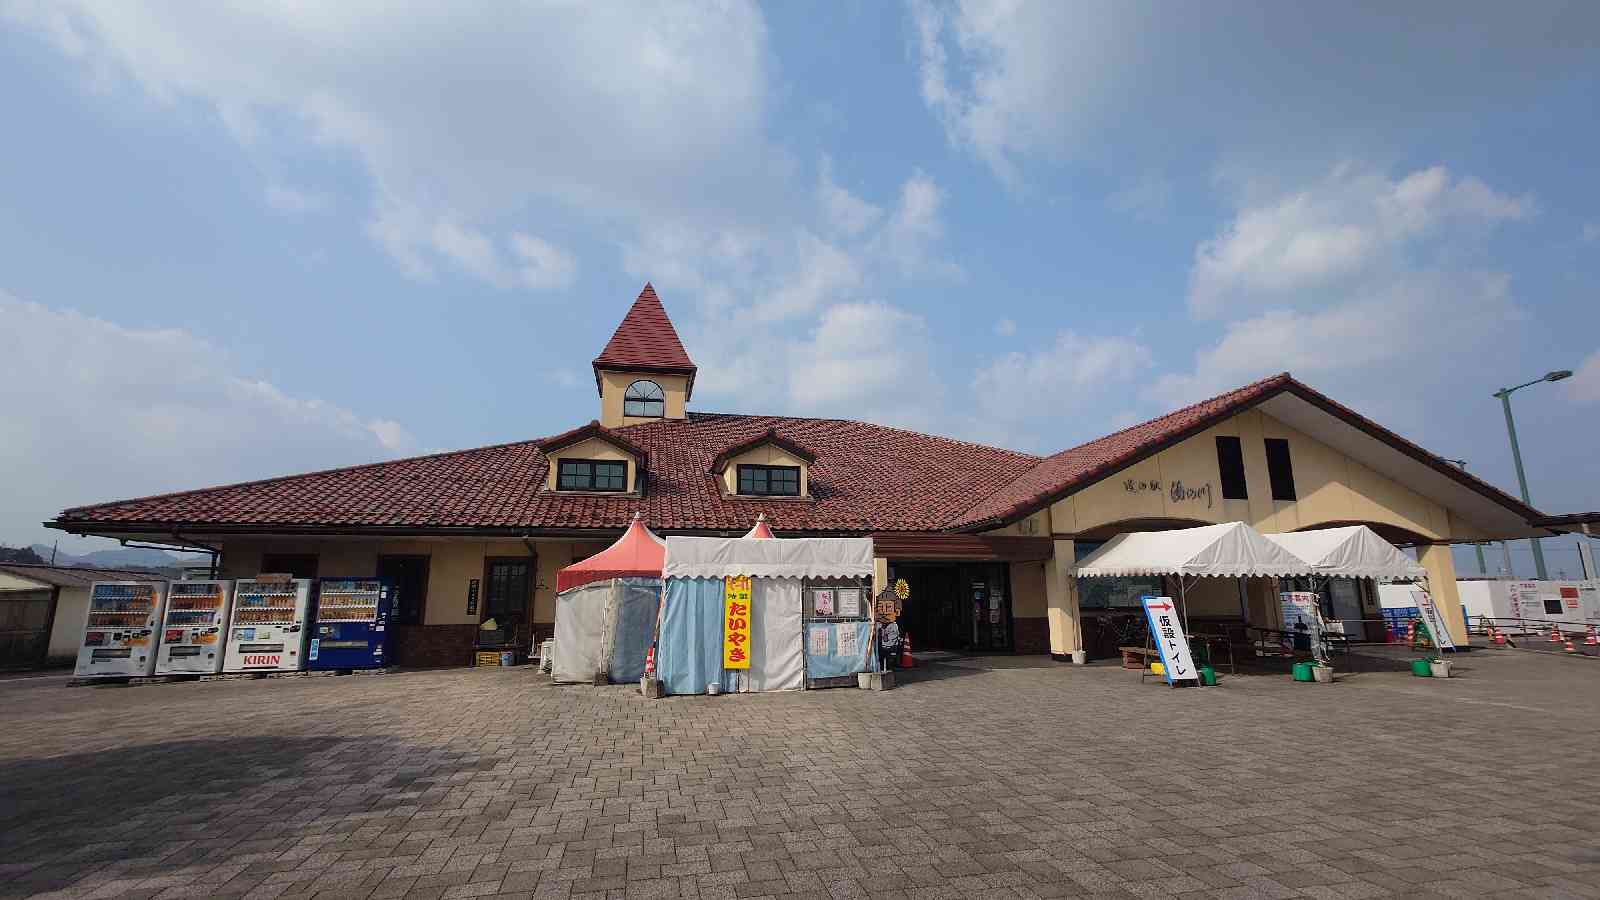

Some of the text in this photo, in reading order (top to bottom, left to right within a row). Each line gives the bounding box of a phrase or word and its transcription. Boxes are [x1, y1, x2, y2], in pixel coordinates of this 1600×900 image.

[243, 655, 280, 665] KIRIN
[728, 602, 747, 663] たいやき
[1159, 615, 1187, 676] 仮設トイレ
